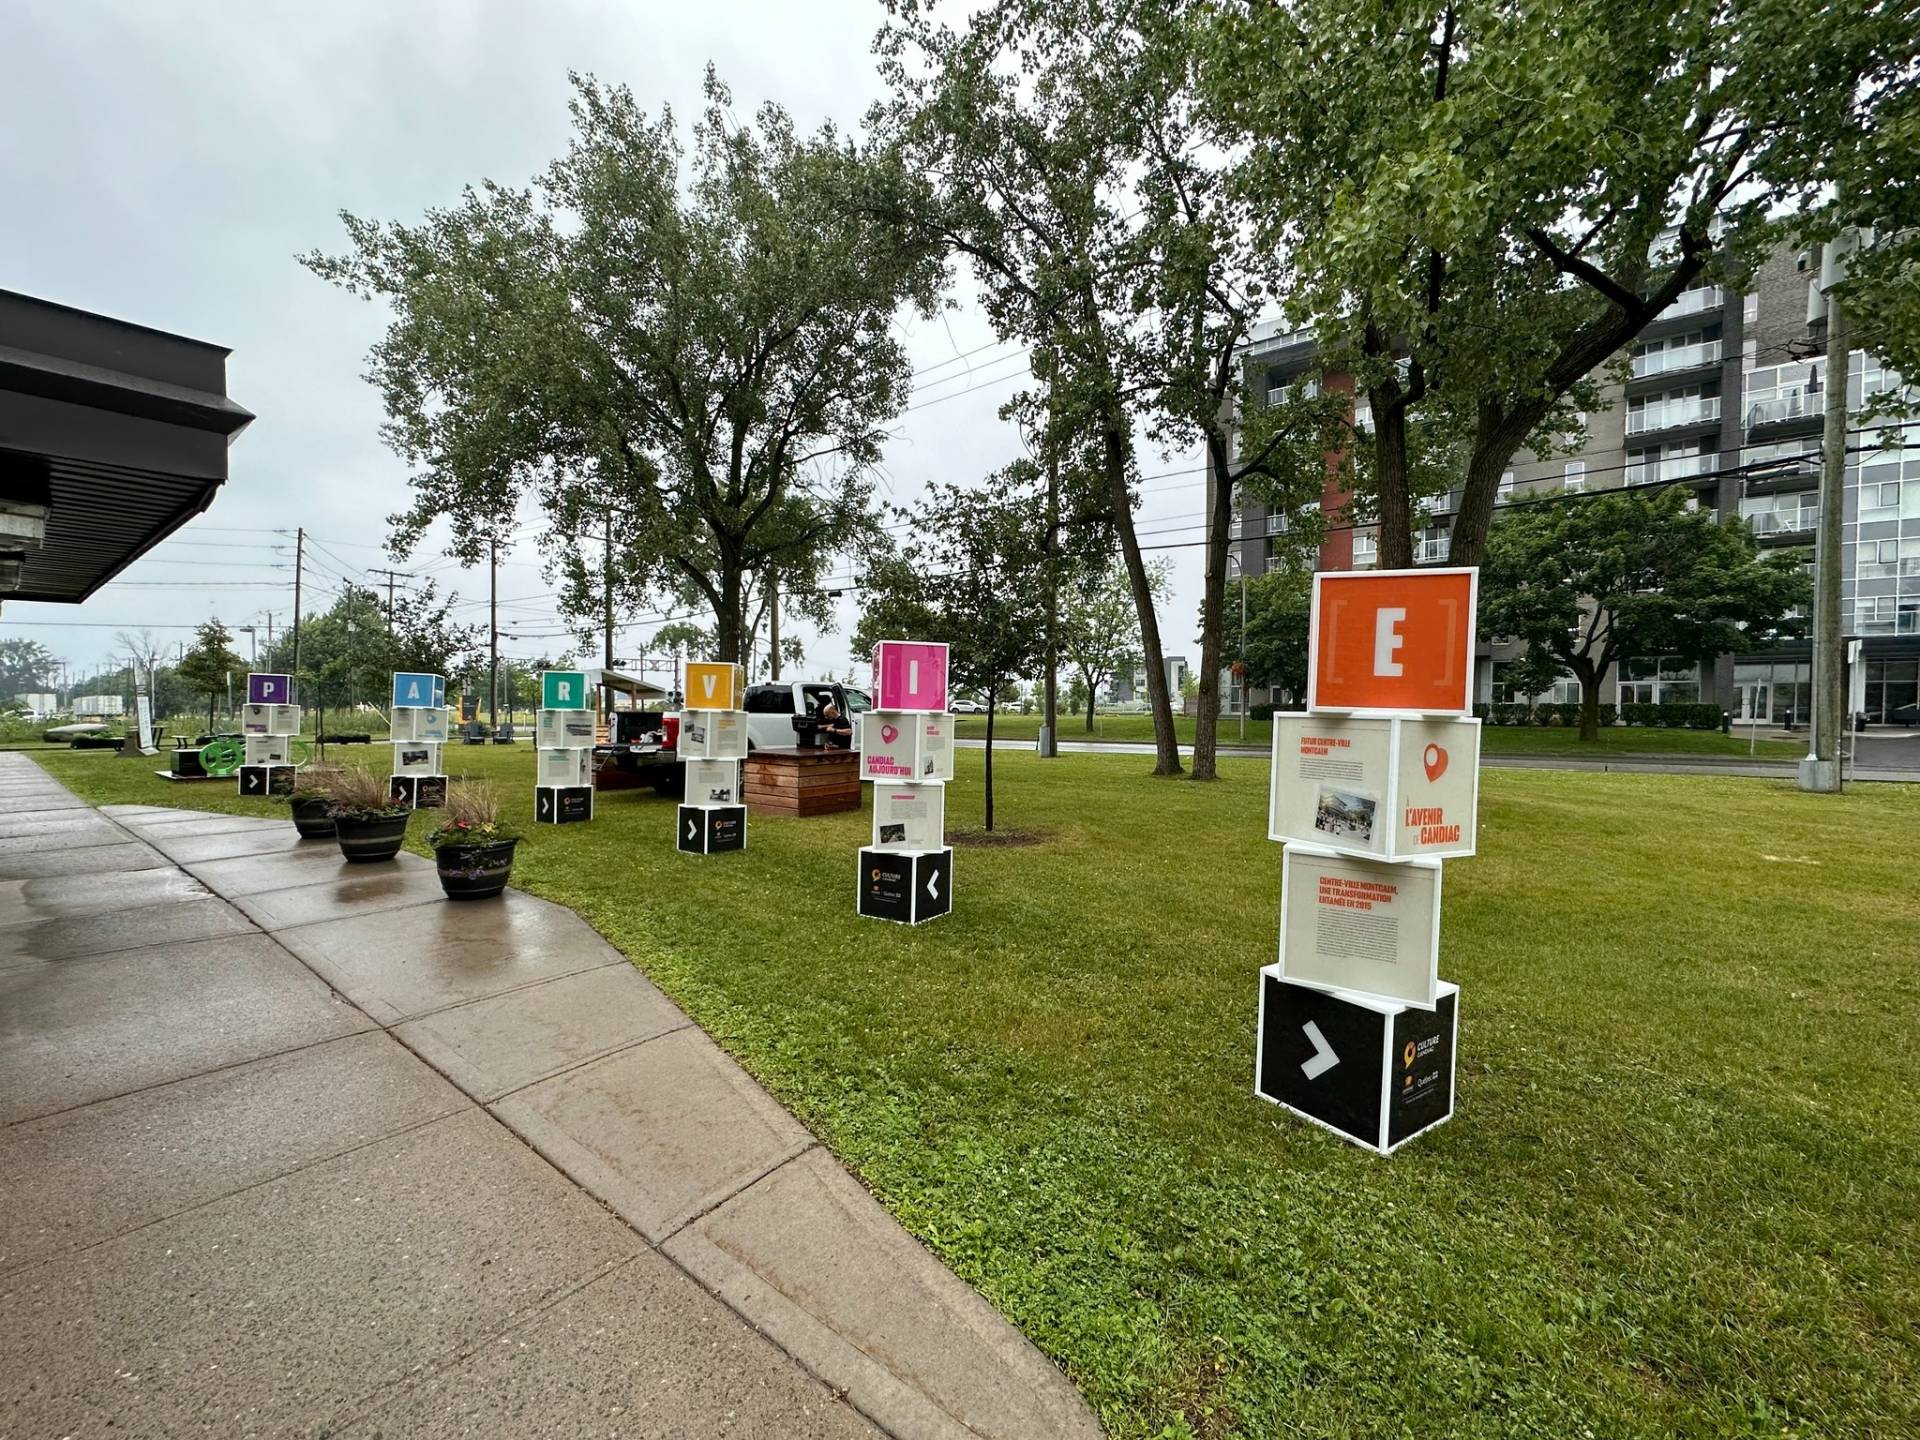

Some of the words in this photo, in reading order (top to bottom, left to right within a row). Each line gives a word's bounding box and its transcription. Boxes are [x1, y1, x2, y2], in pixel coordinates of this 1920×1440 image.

[1373, 607, 1406, 677] E
[909, 660, 918, 695] I
[263, 682, 274, 697] P
[407, 682, 420, 699] A
[558, 681, 570, 700] R
[702, 675, 717, 698] V
[1300, 736, 1317, 746] FUTUR
[867, 755, 895, 766] CANDIAC
[868, 765, 912, 777] AUJOURD'HUI
[1405, 807, 1443, 827] L'AVENIR
[1420, 825, 1460, 845] CANDIAC
[1319, 876, 1360, 889] CENTRE-VILLE
[1319, 886, 1331, 895] UNE
[1332, 887, 1392, 903] TRANSFORMATION
[1346, 899, 1355, 908] EN
[1355, 901, 1372, 910] 2015
[1417, 1034, 1440, 1051] CULTURE
